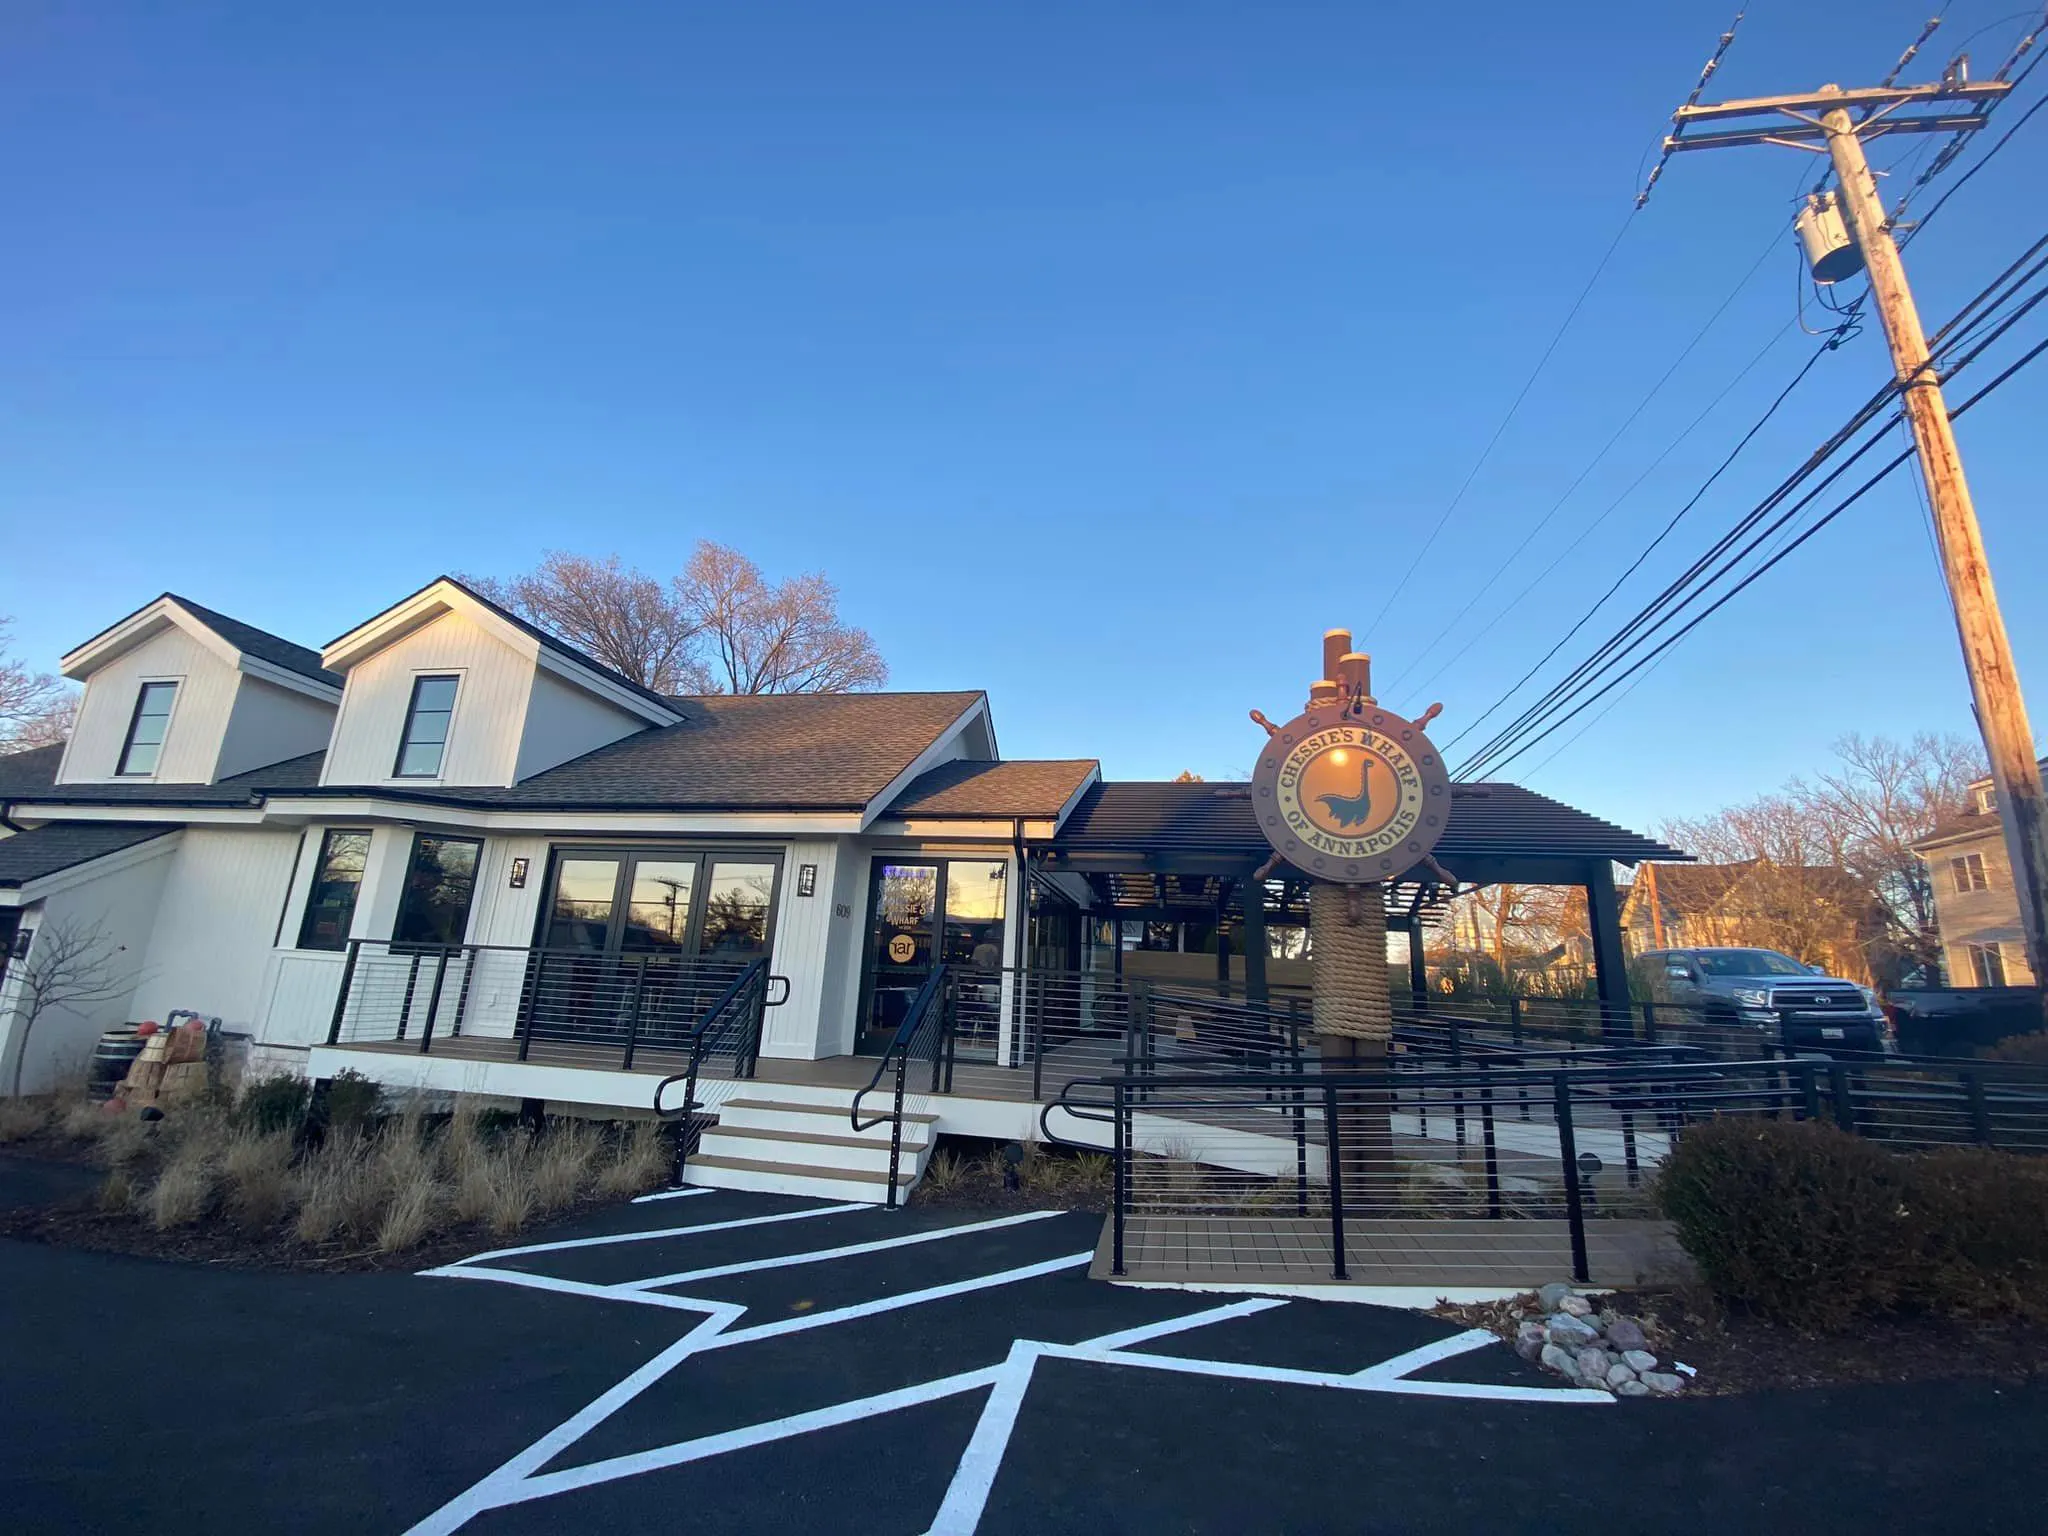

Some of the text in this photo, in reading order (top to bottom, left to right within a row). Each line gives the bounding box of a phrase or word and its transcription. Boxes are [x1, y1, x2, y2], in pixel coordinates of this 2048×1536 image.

[1281, 729, 1418, 788] CHESSIE'S WHARF
[1287, 810, 1415, 855] OF ANNAPOLIS
